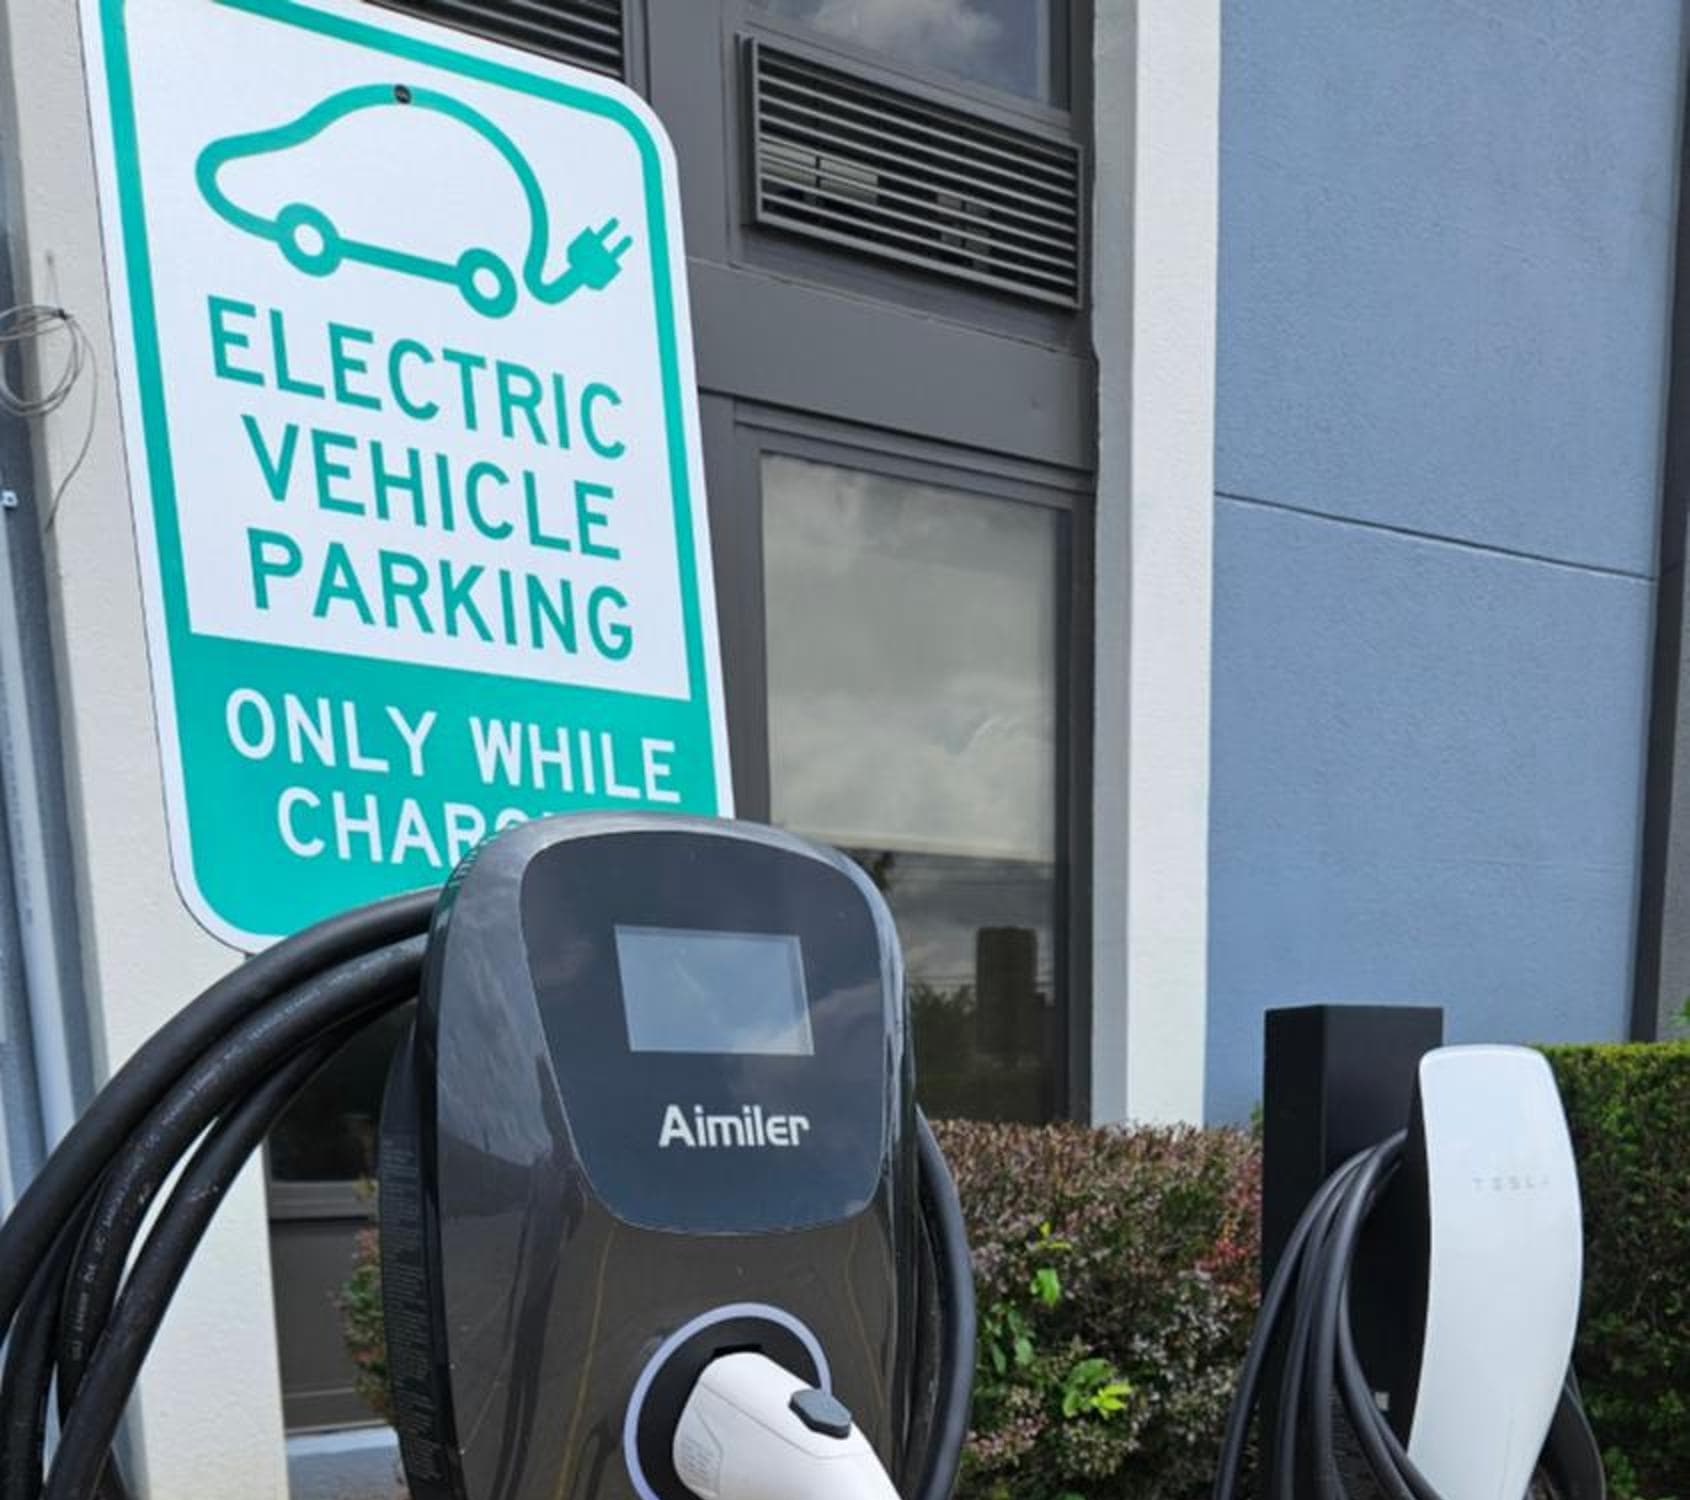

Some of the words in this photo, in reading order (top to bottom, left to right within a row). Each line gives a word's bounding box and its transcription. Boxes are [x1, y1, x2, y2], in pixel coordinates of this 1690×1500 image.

[207, 294, 627, 460] ELECTRIC
[241, 414, 622, 561] VEHICLE
[246, 527, 635, 663] PARKING
[226, 688, 438, 776] ONLY
[469, 716, 681, 803] WHILE
[278, 786, 557, 867] CHAR
[658, 1104, 810, 1147] Aimiler
